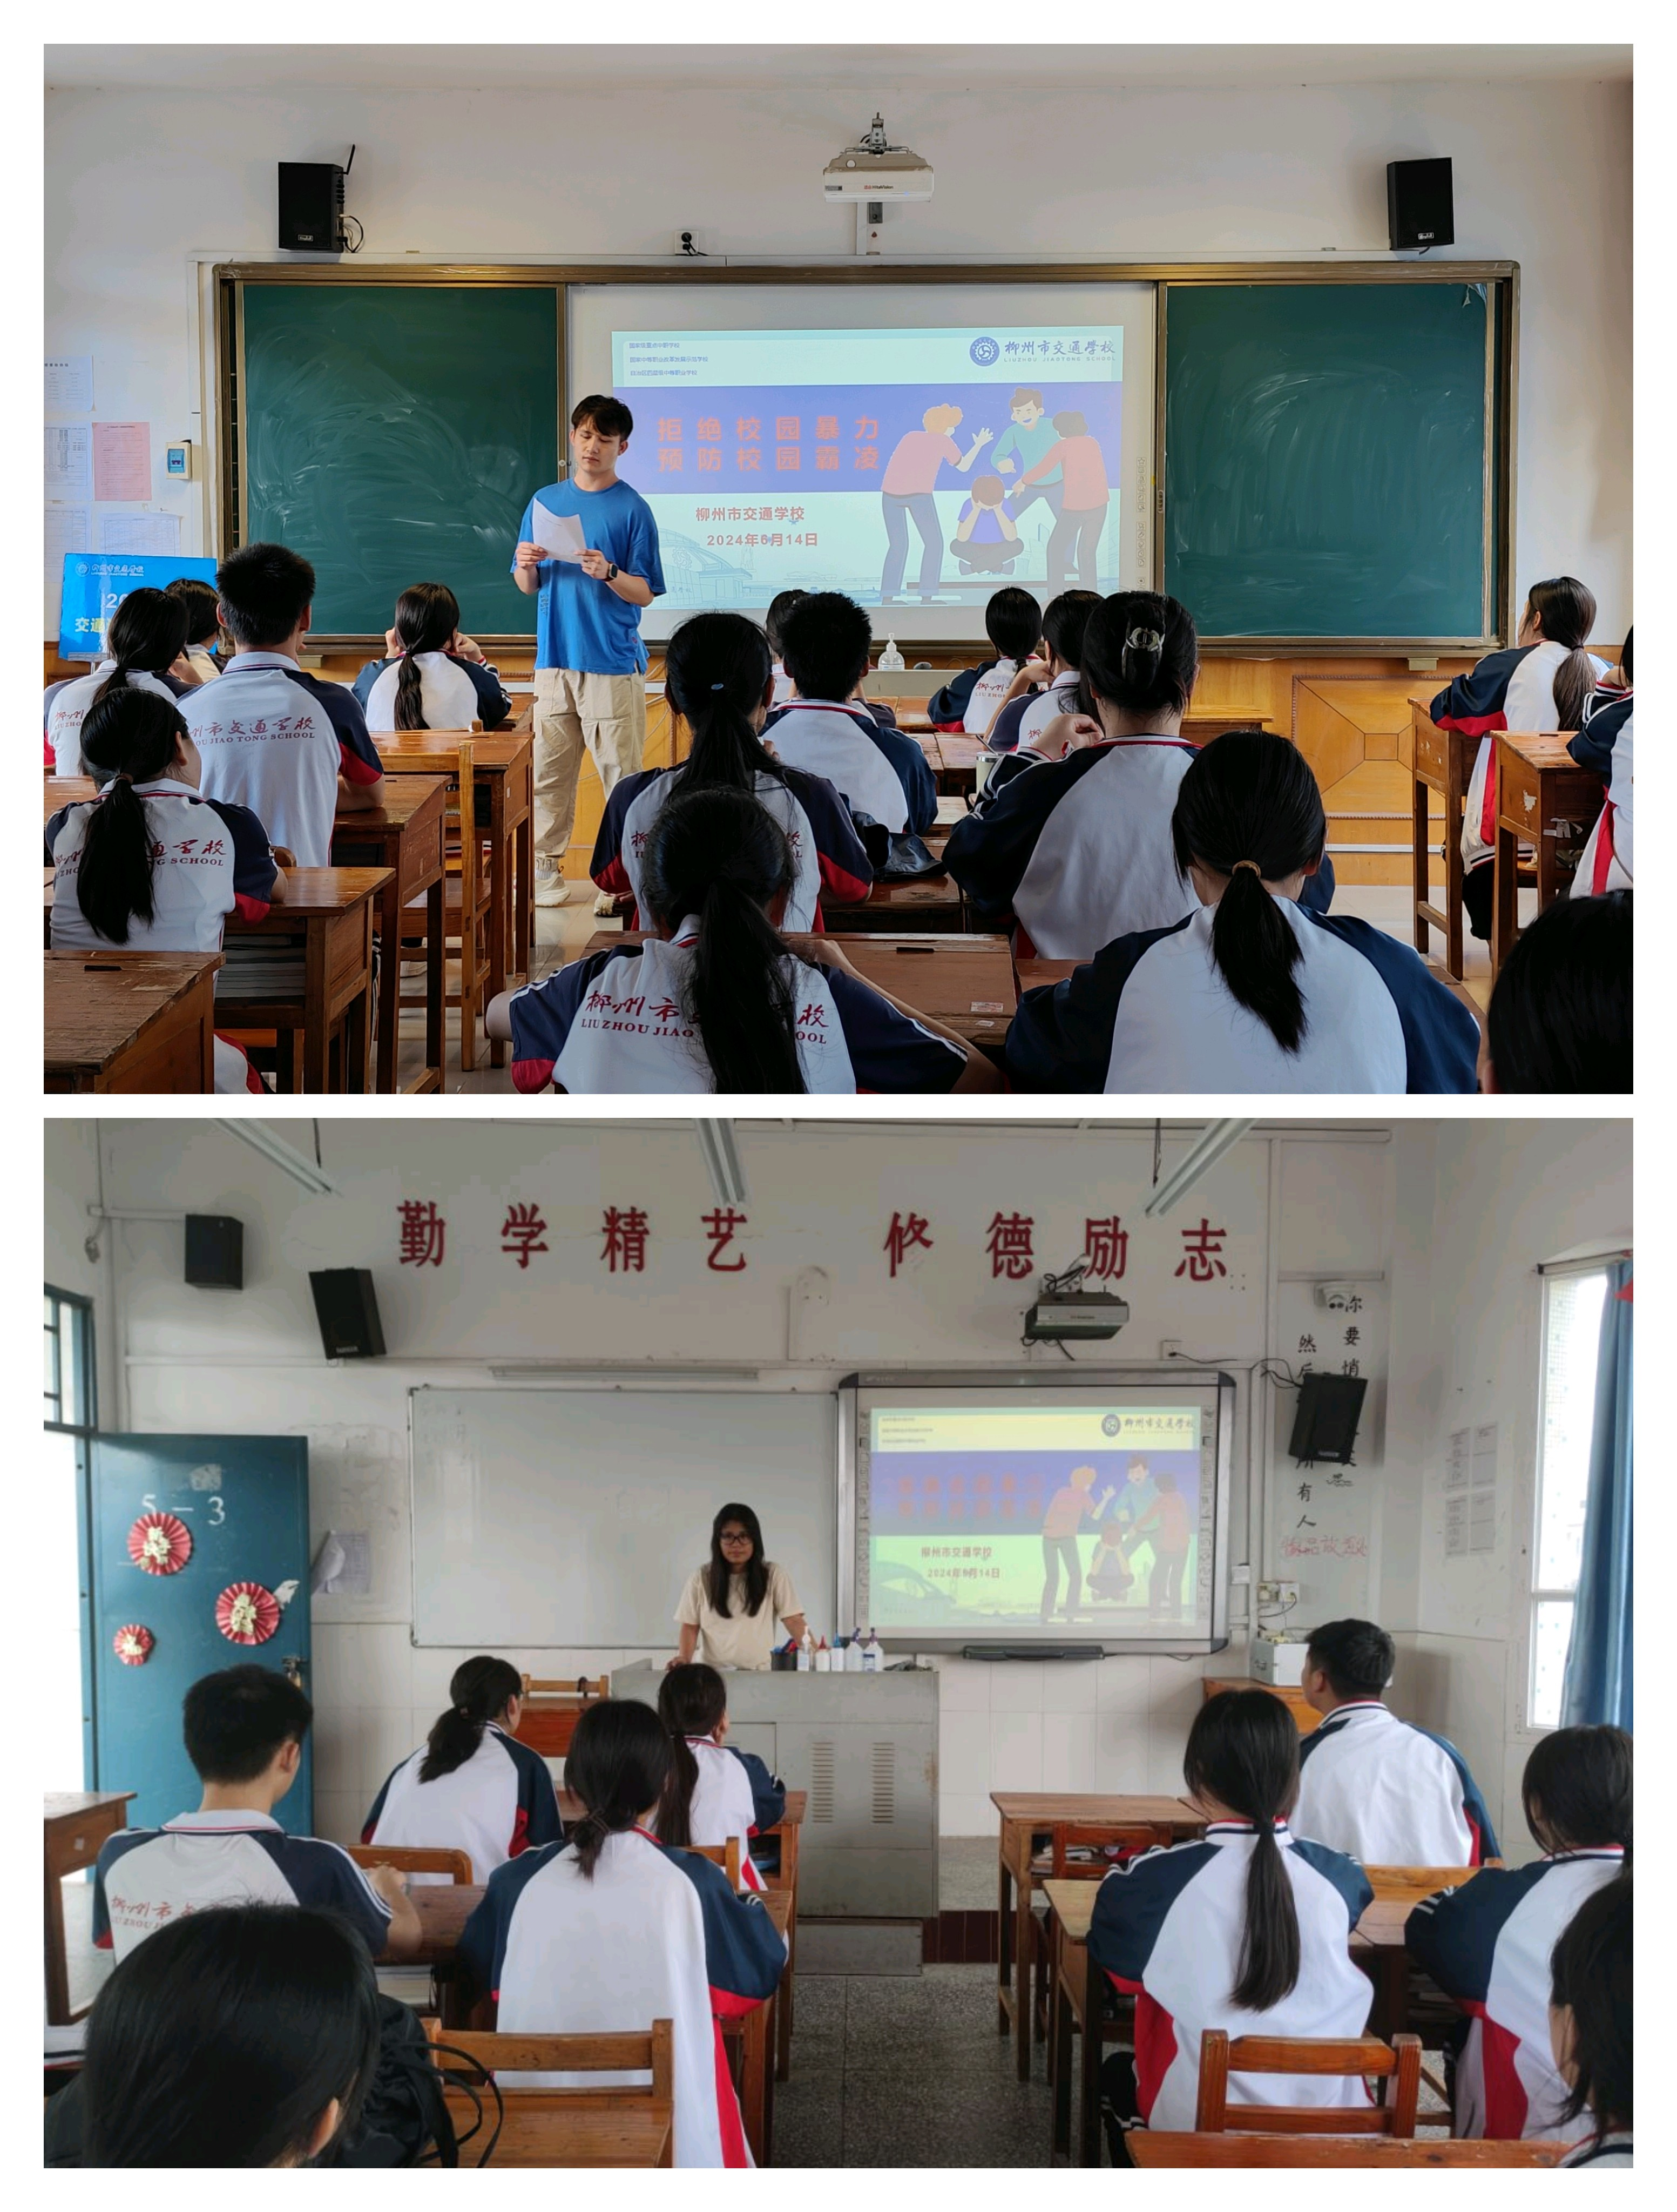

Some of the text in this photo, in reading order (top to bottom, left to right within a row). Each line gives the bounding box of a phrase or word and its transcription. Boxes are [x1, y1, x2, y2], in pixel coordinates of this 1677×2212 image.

[657, 415, 879, 442] 拒绝校园暴力
[657, 447, 880, 473] 预防校园霸凌
[695, 507, 805, 522] 柳州市交通学校
[707, 533, 817, 547] 2024年6月14日
[55, 721, 82, 731] LIUZHO
[190, 717, 316, 737] 州市交通学校
[170, 858, 224, 866] SCHOOL
[581, 1019, 650, 1034] LIUZHOU
[652, 1026, 694, 1037] JIAO
[396, 1200, 748, 1273] 勤学精艺
